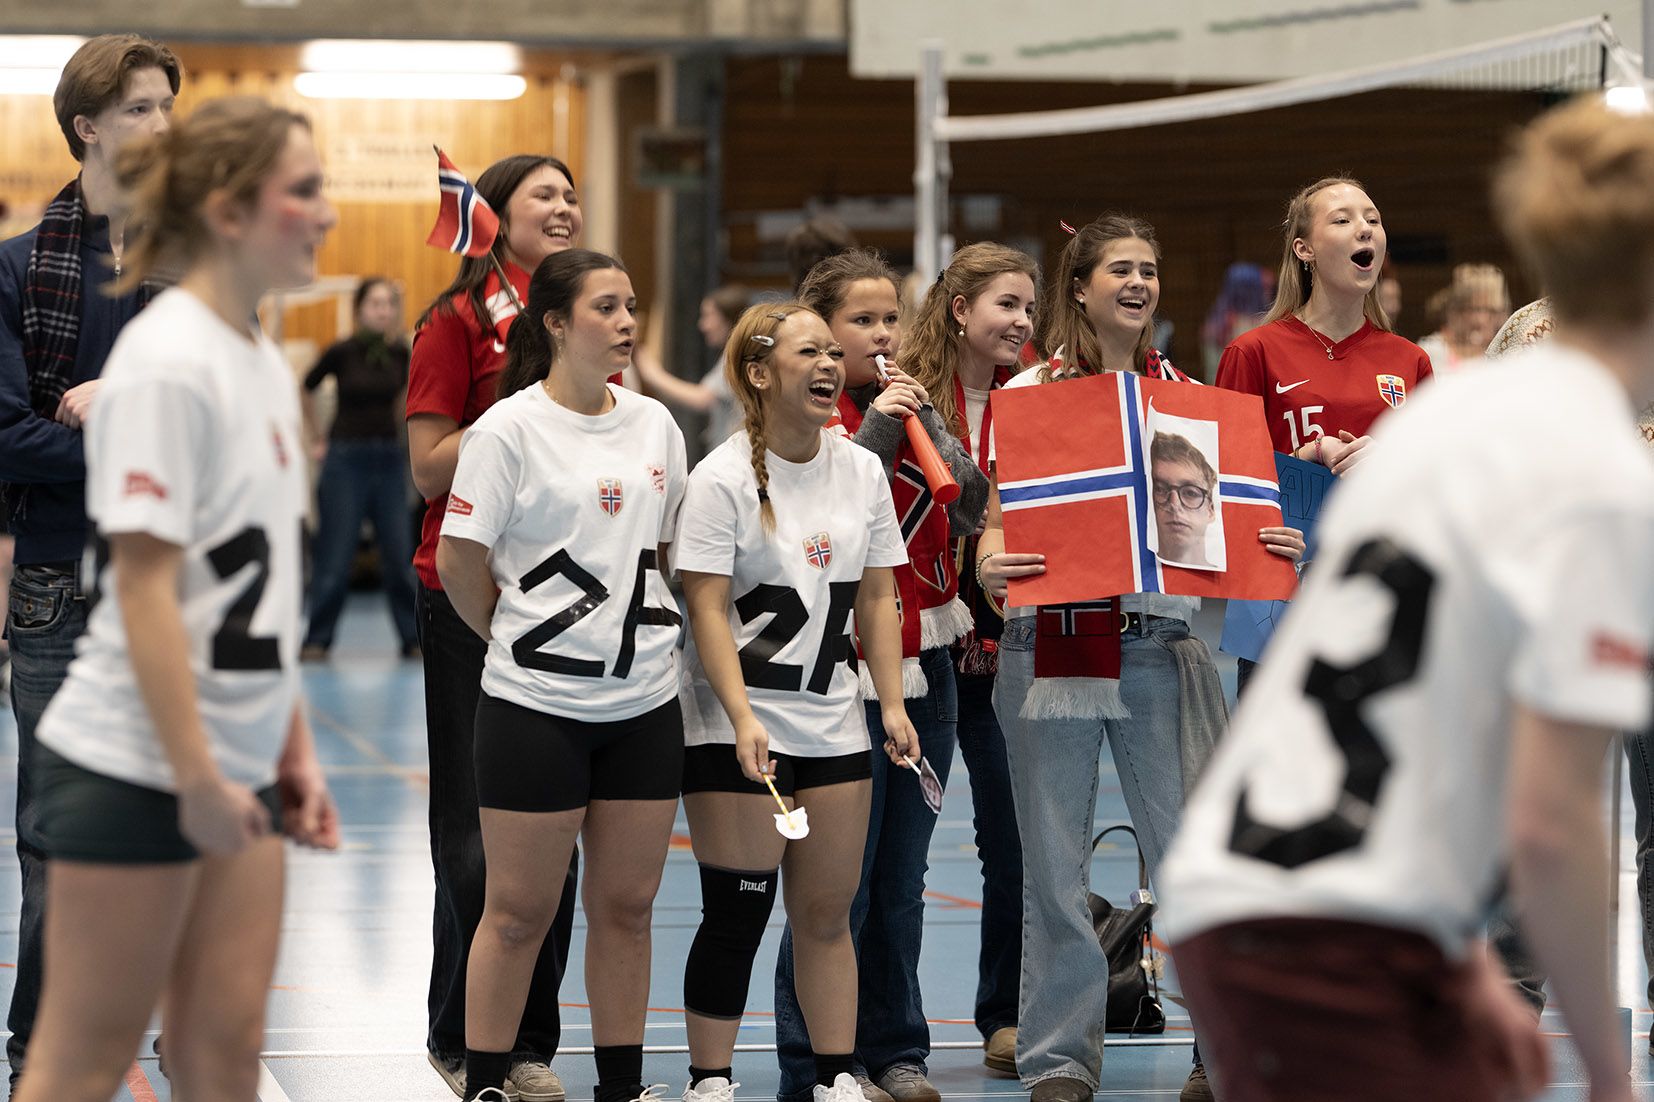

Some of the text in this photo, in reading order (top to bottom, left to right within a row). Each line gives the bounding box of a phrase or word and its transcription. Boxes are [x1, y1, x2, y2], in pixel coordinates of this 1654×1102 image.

[1283, 405, 1324, 452] 15
[1226, 537, 1438, 869] 3
[740, 879, 768, 893] EVERLAST
